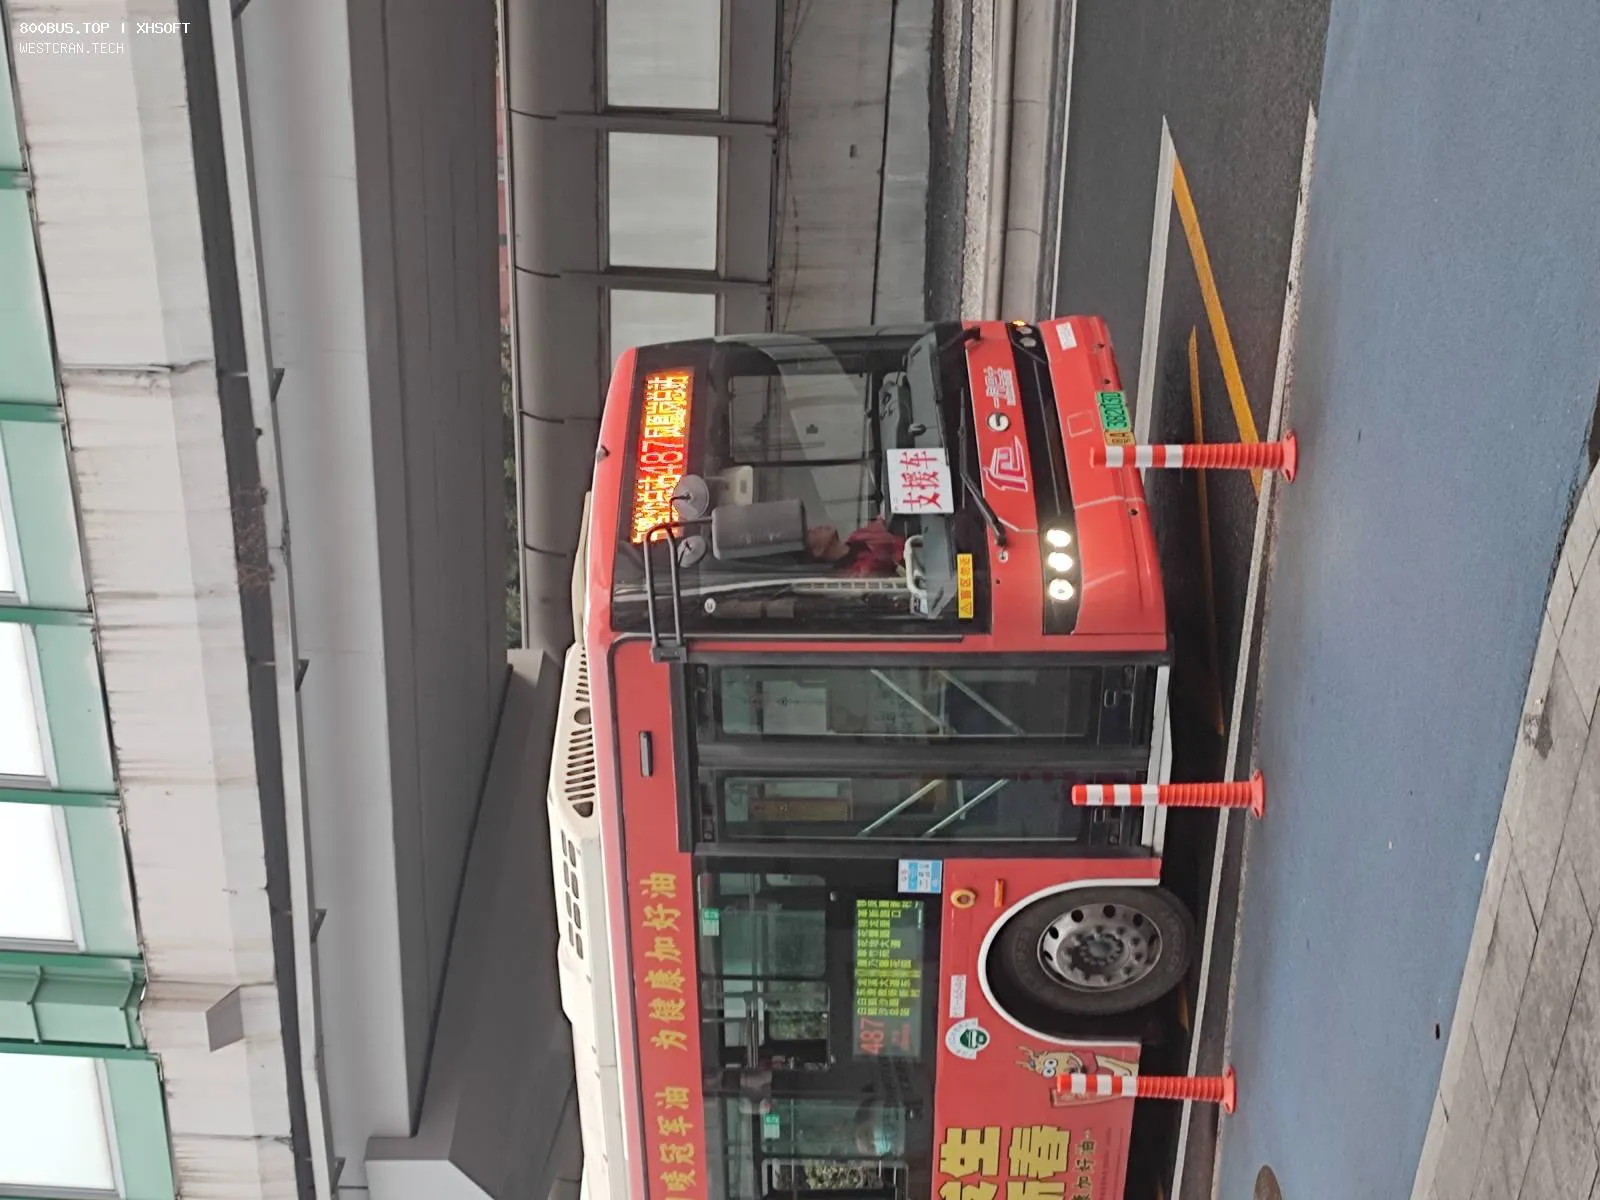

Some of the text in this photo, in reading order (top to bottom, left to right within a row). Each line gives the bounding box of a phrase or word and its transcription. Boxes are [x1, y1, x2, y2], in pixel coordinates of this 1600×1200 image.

[640, 438, 685, 476] 487
[899, 450, 943, 513] 支援车
[639, 871, 697, 1200] 唛冠军油 为健康加好油
[859, 1017, 885, 1055] 487
